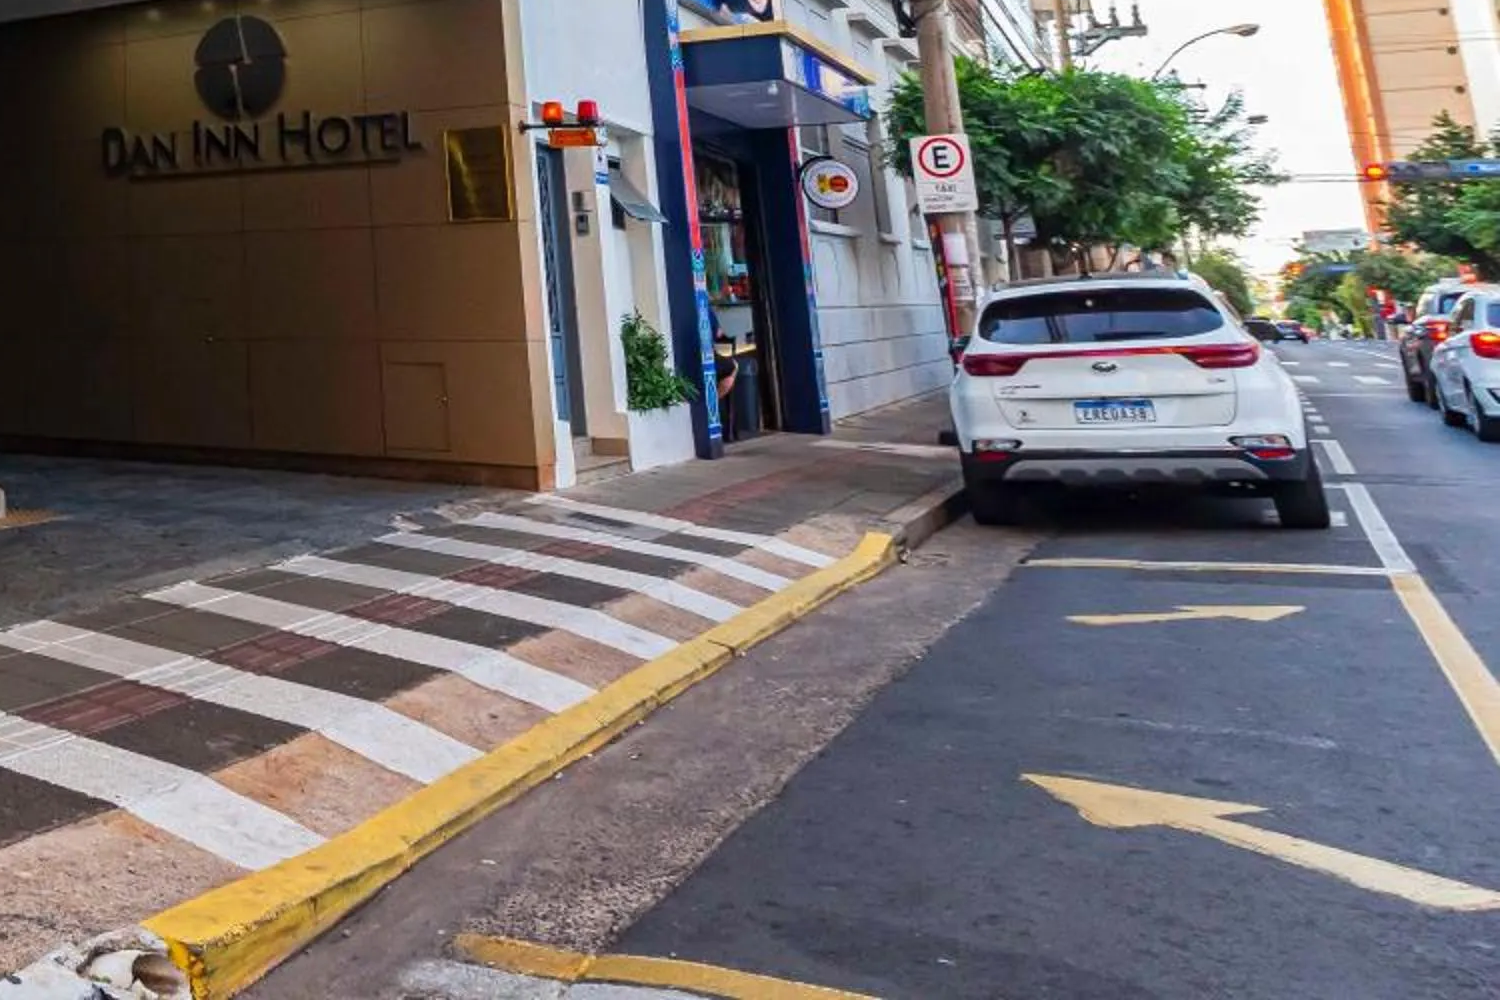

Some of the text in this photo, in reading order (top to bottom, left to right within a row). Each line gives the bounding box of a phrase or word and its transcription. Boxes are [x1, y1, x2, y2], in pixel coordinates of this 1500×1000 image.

[101, 111, 422, 175] DAN INN HOTEL
[932, 145, 950, 168] E
